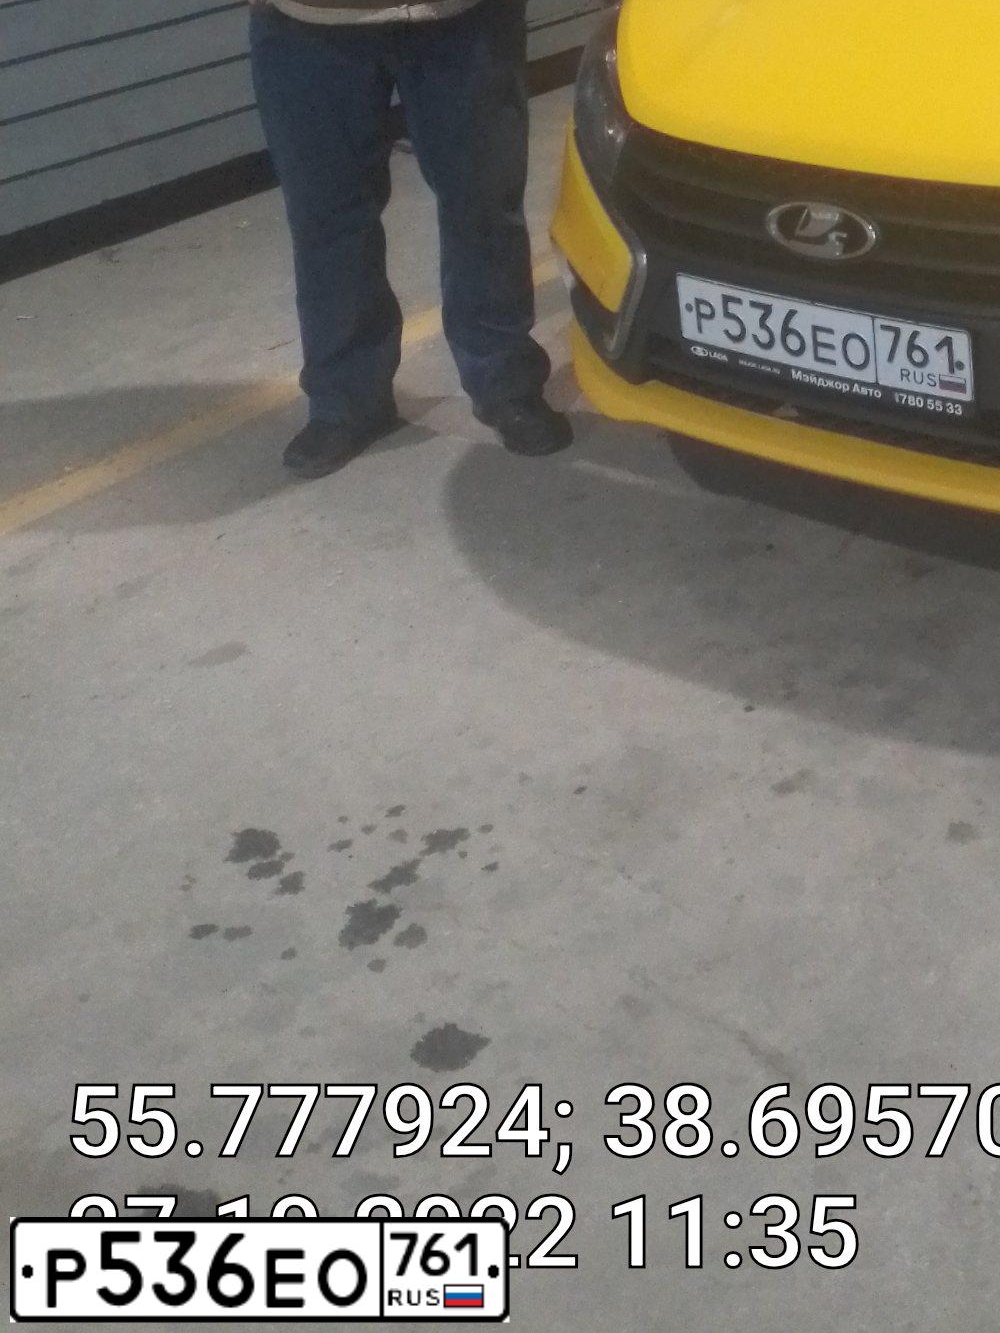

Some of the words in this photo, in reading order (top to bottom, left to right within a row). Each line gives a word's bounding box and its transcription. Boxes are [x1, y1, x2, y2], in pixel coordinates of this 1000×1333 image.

[880, 324, 955, 374] 761
[790, 369, 850, 393] Мэйджор
[852, 382, 882, 399] Авто
[927, 399, 943, 412] 55
[945, 402, 963, 416] 33
[900, 368, 937, 387] RUS
